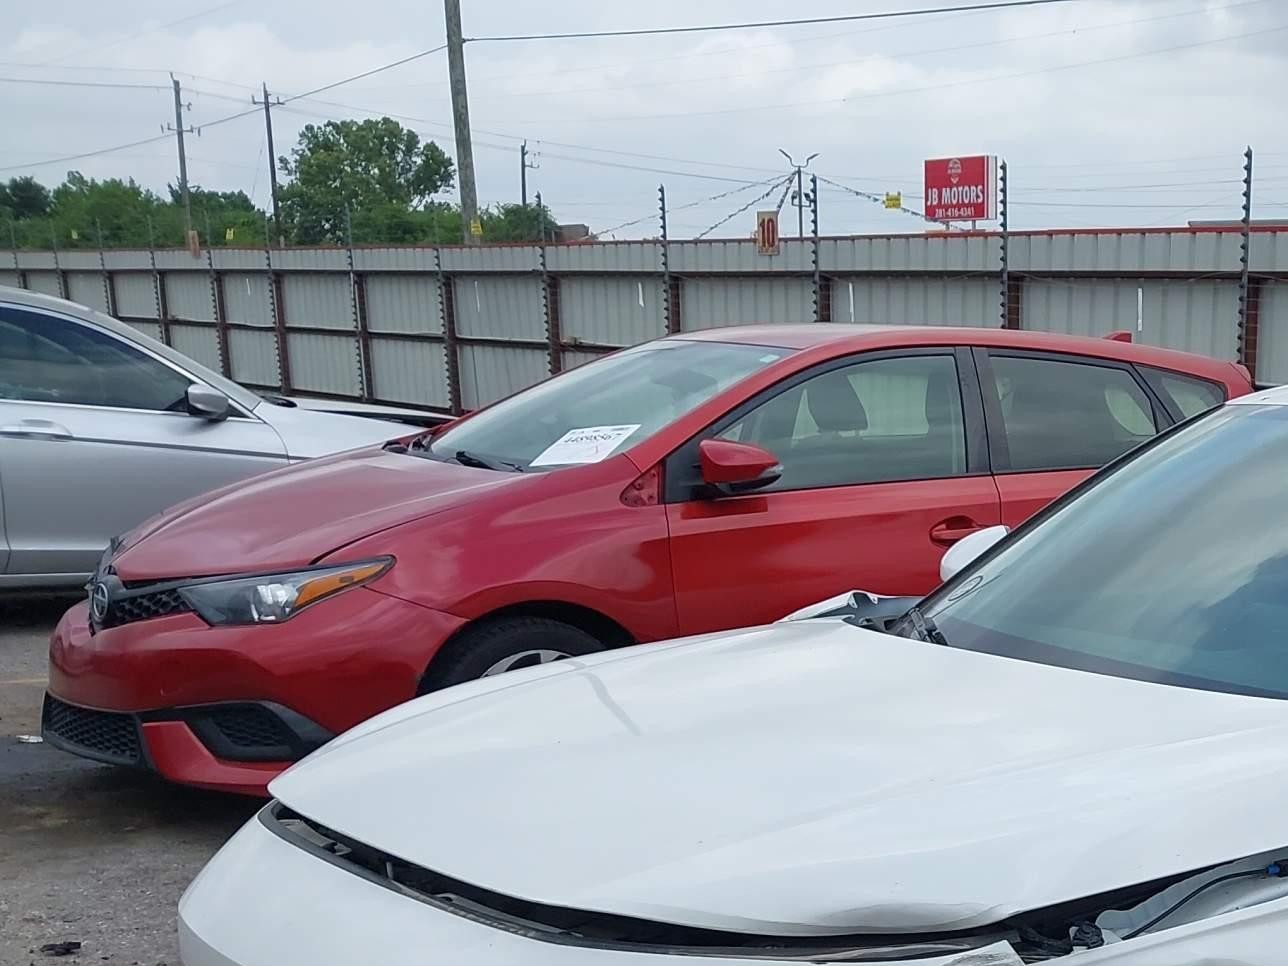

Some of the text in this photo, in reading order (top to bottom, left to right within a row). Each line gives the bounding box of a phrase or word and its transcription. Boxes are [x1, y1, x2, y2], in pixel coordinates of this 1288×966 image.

[927, 185, 984, 206] JB MOTORS
[760, 218, 775, 248] 10
